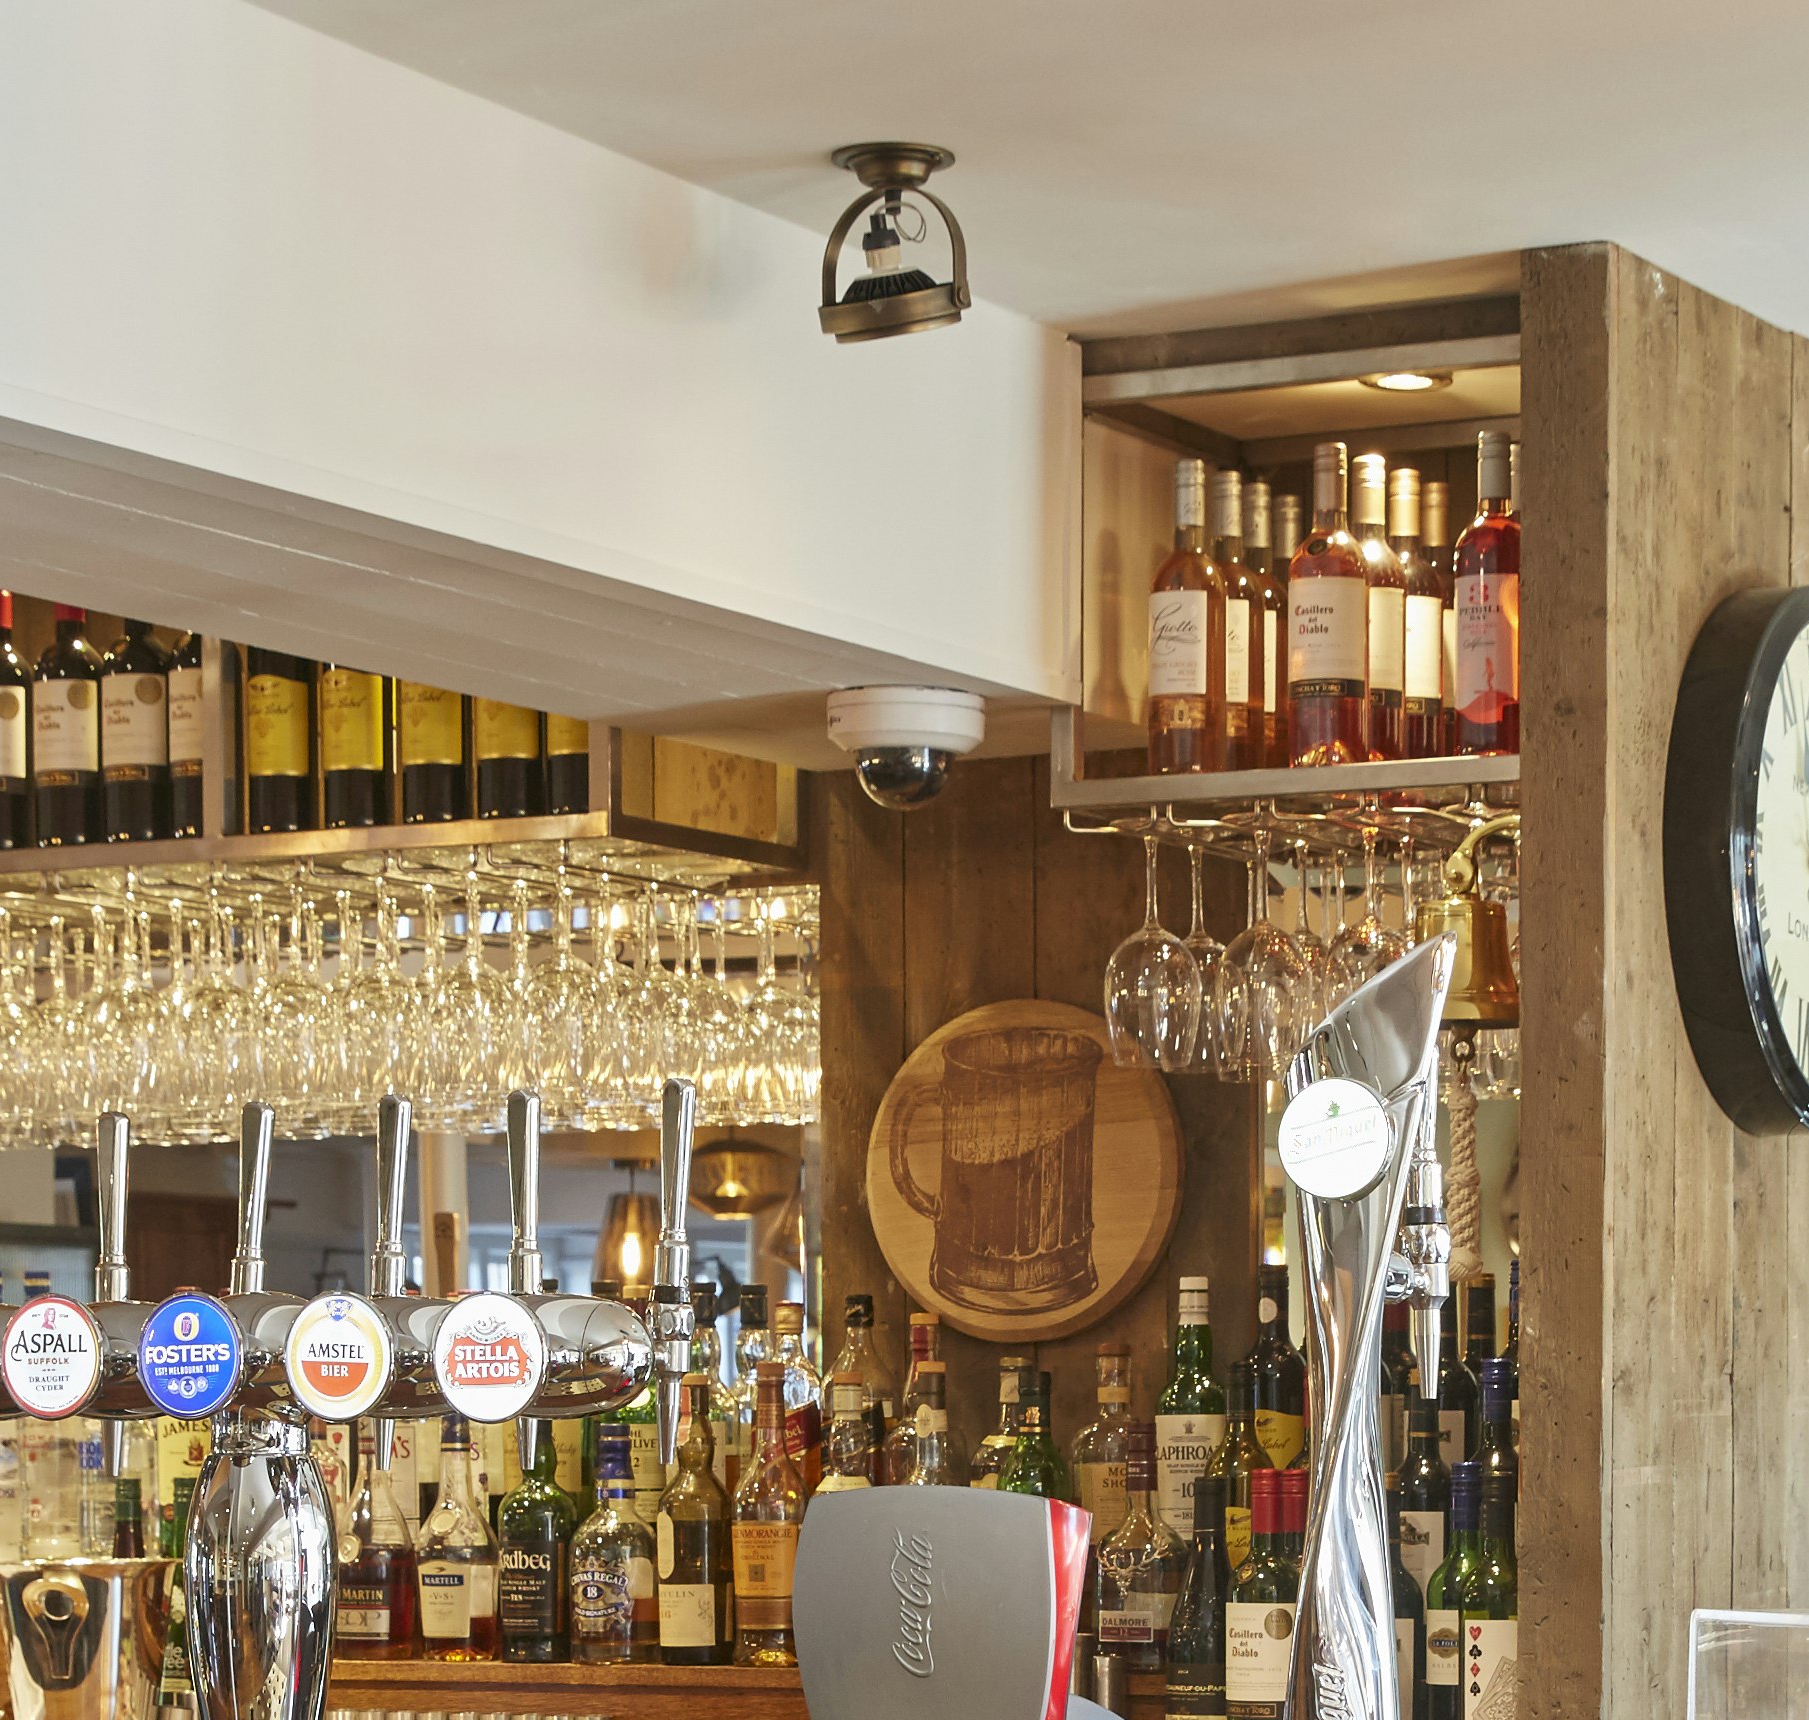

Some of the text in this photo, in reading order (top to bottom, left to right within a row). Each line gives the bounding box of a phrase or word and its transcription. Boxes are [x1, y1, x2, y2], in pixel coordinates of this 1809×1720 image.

[1294, 604, 1334, 617] Casillero
[1298, 623, 1329, 634] Diablo
[10, 1329, 88, 1362] ASPALL
[307, 1343, 364, 1359] AMSTEL
[145, 1343, 231, 1365] FOSTER'S
[454, 1345, 520, 1361] STELLA
[27, 1357, 70, 1365] SUFFOLK
[168, 1365, 204, 1376] MELBOURNE
[321, 1364, 349, 1377] BIER
[454, 1361, 520, 1379] ARTOIS
[29, 1375, 70, 1383] DRAUGHT
[35, 1384, 64, 1392] CYDER
[162, 1419, 210, 1438] JAMES
[1157, 1445, 1221, 1461] LAPHROA
[734, 1528, 793, 1539] ENMORANGIE
[424, 1576, 460, 1585] MARTELL
[593, 1571, 625, 1587] REGAL
[342, 1588, 384, 1600] MARTIN
[586, 1586, 598, 1598] 18
[660, 1590, 695, 1598] VULIN
[890, 1526, 935, 1678] Coca-Cola
[1102, 1617, 1149, 1626] DALMORE
[1228, 1627, 1264, 1639] Casillero
[1231, 1646, 1259, 1658] Diablo
